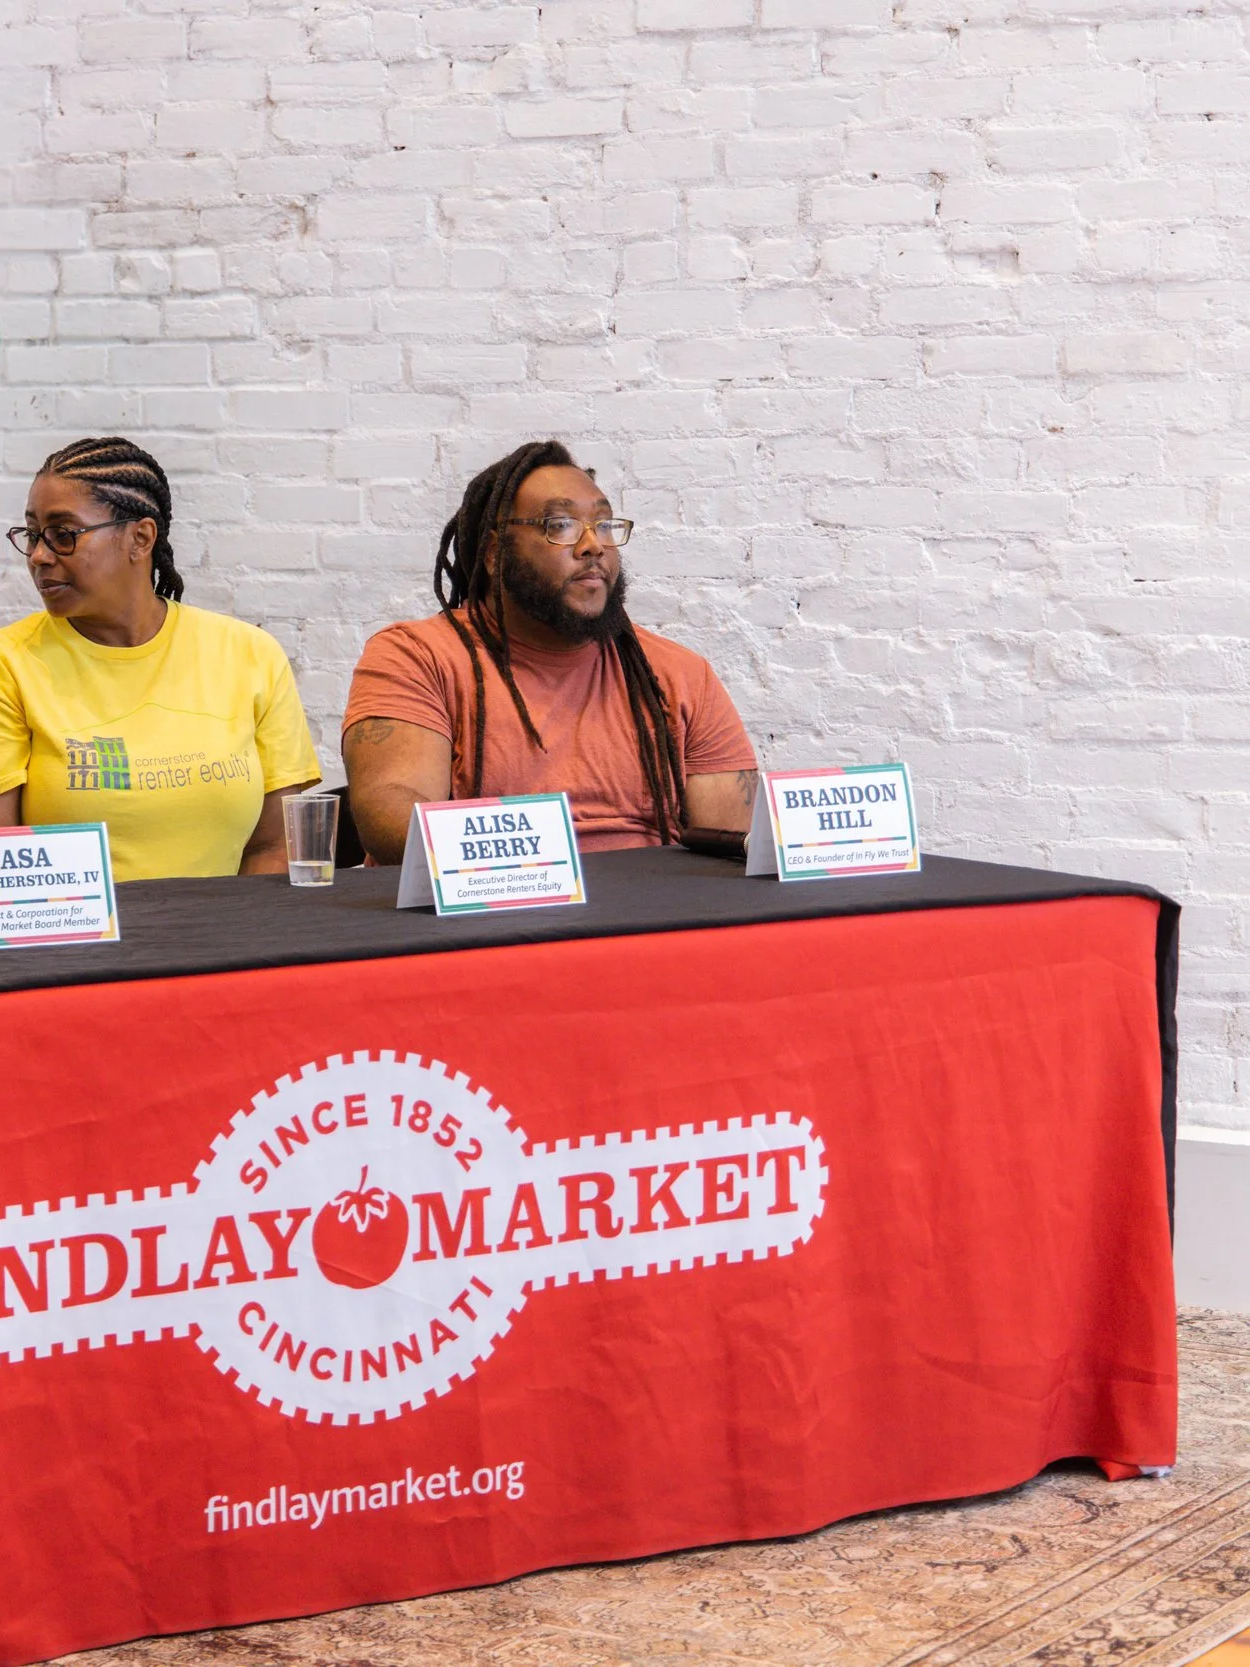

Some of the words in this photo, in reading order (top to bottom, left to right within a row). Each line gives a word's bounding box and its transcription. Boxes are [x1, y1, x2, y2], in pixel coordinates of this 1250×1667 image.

[135, 751, 206, 768] cornerstone
[138, 767, 191, 790] renter
[200, 753, 250, 786] equity
[783, 783, 897, 809] BRANDON
[463, 812, 533, 836] ALISA
[817, 810, 872, 831] HILL
[1, 847, 52, 869] ASA
[460, 836, 541, 861] BERRY
[788, 856, 804, 865] CEO
[814, 852, 844, 863] Founder
[847, 851, 854, 863] of
[865, 851, 876, 861] Fly
[878, 850, 889, 858] We
[892, 849, 909, 857] Trust
[84, 871, 99, 883] IV
[468, 876, 506, 886] Executive
[508, 872, 537, 882] Director
[539, 871, 548, 882] of
[457, 887, 505, 898] Cornerstone
[507, 884, 535, 893] Renters
[537, 882, 562, 892] Equity
[1, 921, 32, 931] Market
[35, 919, 61, 929] Board
[64, 917, 100, 926] Member
[7, 911, 14, 919] &
[16, 908, 68, 920] Corporation
[70, 906, 83, 917] for
[236, 1092, 372, 1194] SINCE
[388, 1094, 487, 1172] 1852
[409, 1145, 807, 1263] MARKET
[235, 1275, 495, 1384] CINCINNATI
[205, 1460, 526, 1534] findlaymarket.org
